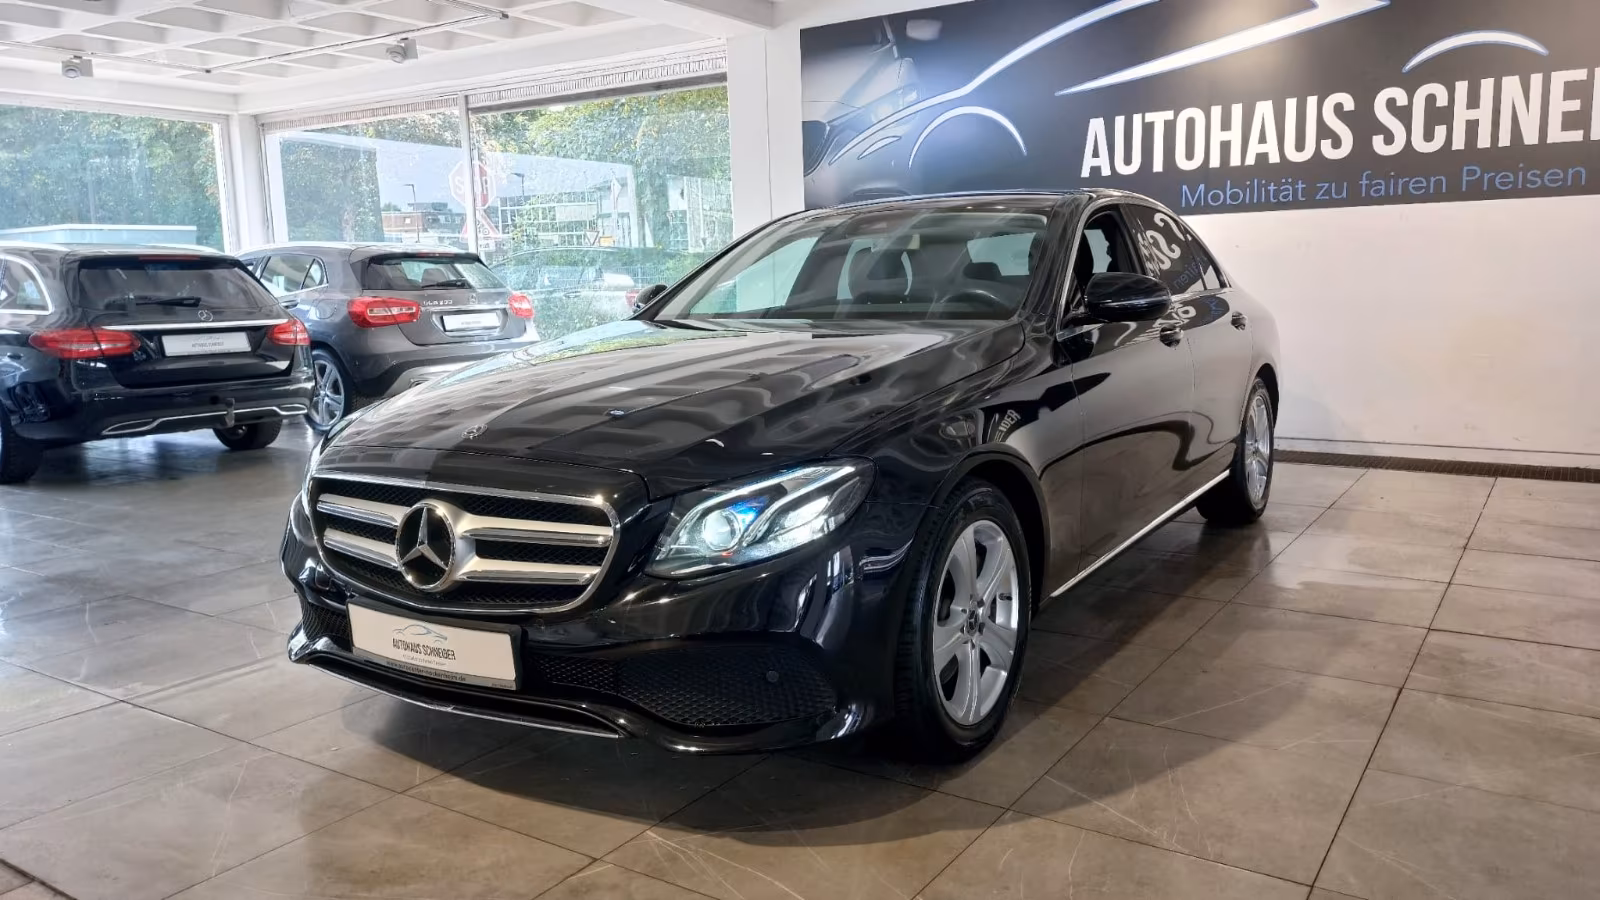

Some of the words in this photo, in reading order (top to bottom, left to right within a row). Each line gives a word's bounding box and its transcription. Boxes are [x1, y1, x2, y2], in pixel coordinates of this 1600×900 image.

[1080, 93, 1355, 177] AUTOHAUS
[1181, 177, 1306, 208] Mobilität
[1315, 181, 1347, 199] zu
[1359, 170, 1447, 197] fairen
[1461, 163, 1587, 192] Preisen
